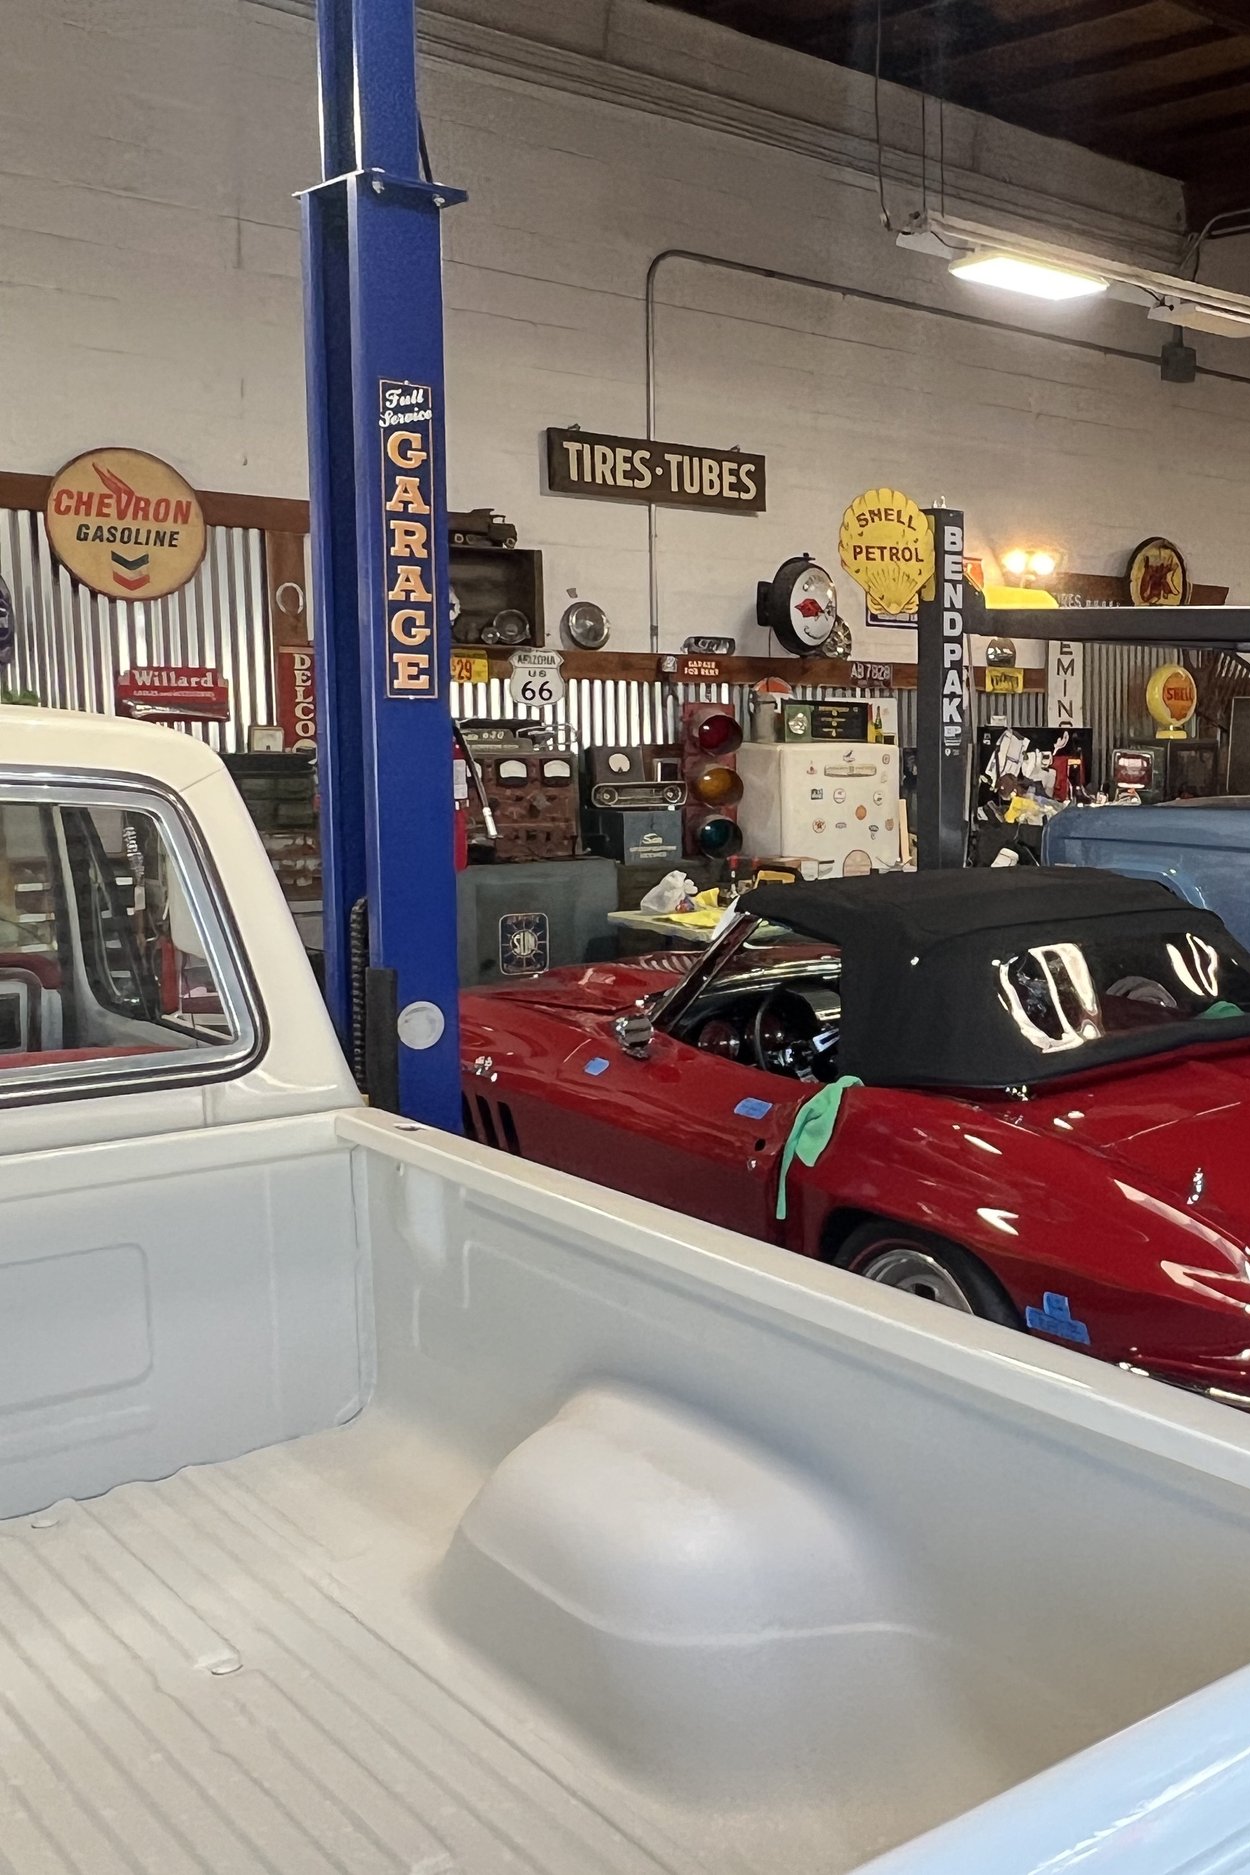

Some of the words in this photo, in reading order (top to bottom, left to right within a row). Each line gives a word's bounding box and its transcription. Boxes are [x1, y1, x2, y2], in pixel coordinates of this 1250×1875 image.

[385, 388, 425, 408] Full
[379, 407, 432, 427] Service
[53, 488, 192, 525] CHEVRON
[856, 508, 916, 531] SHELL
[76, 523, 180, 547] GASOLINE
[386, 430, 432, 689] GARAGE
[853, 544, 924, 562] PETROL
[942, 526, 963, 724] BENDPAK
[132, 670, 214, 688] Willard
[293, 654, 316, 737] DELCO
[521, 680, 553, 701] 66
[1166, 687, 1193, 701] SHELL
